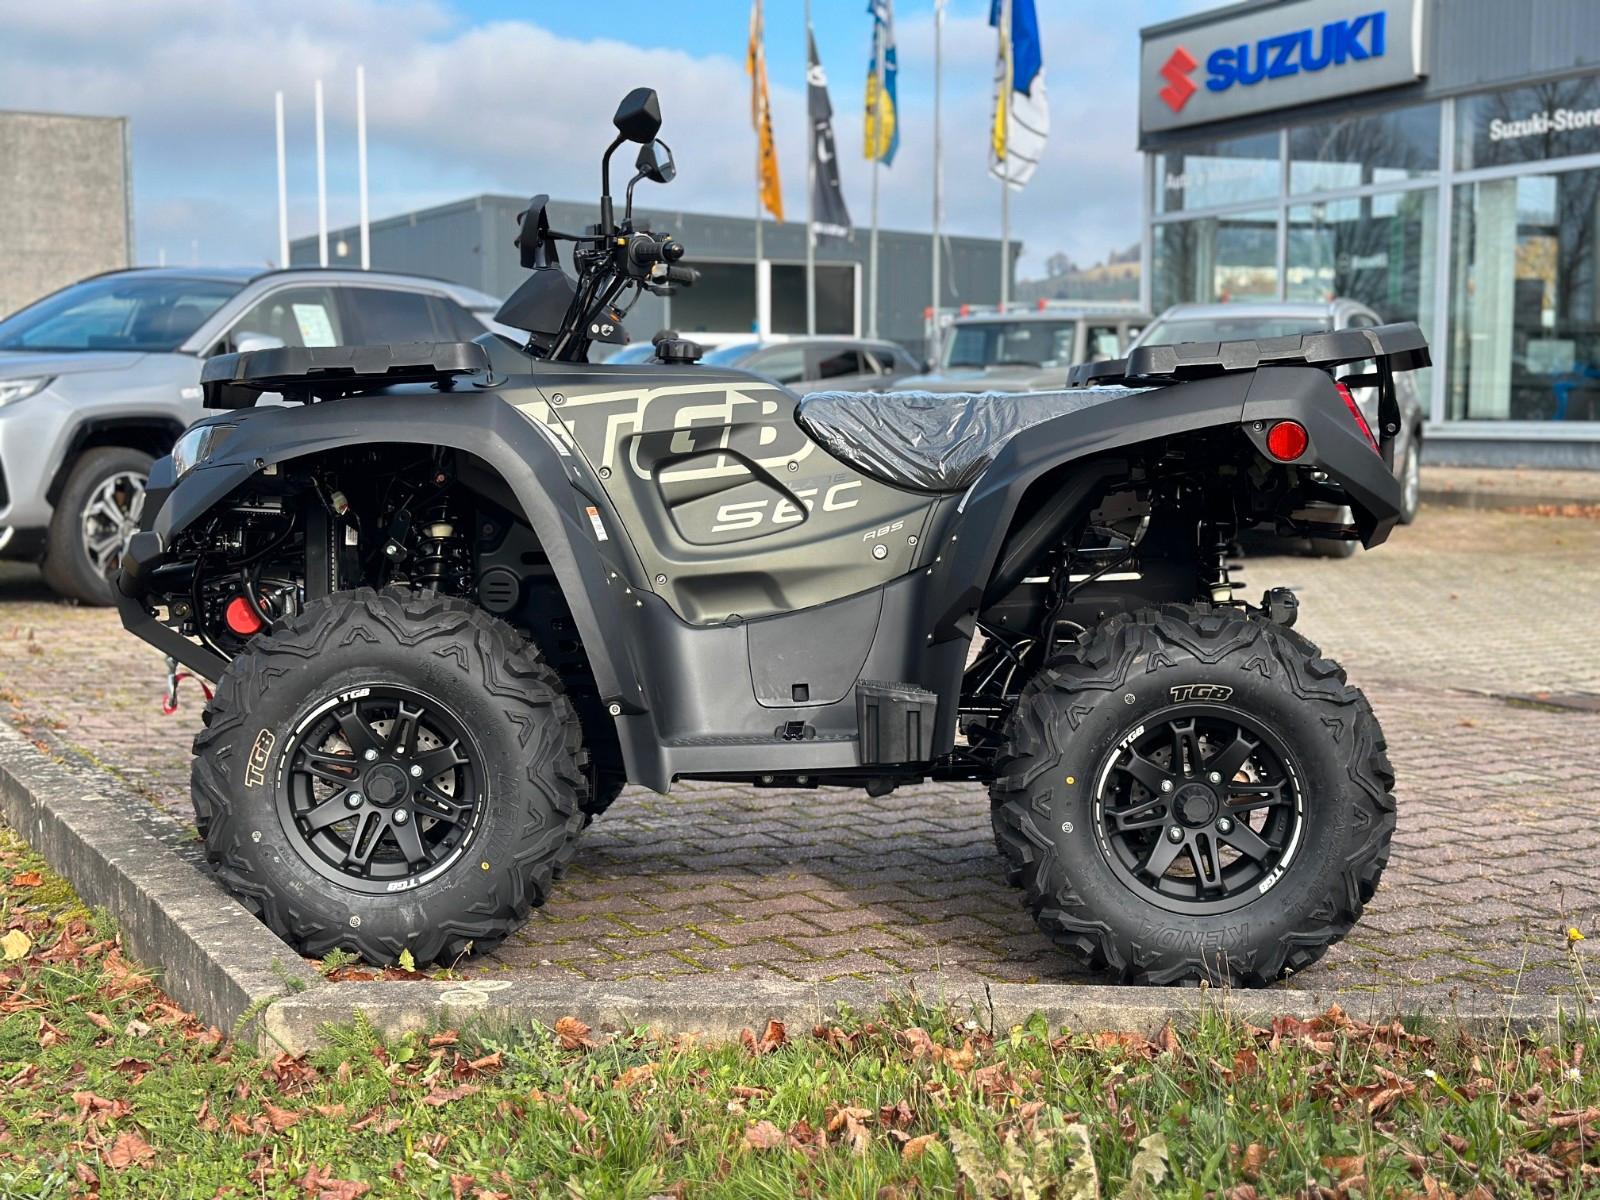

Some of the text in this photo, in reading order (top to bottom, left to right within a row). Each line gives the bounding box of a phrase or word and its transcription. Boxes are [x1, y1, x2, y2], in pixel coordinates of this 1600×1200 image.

[1206, 11, 1386, 92] SUZUKI
[514, 382, 816, 483] TGB
[863, 520, 904, 542] ABS
[339, 687, 371, 703] TGB
[1169, 683, 1234, 703] TGB
[1118, 725, 1146, 750] TGB
[244, 728, 276, 789] TGB
[386, 881, 419, 893] TGB
[1258, 868, 1285, 896] TGB
[1138, 917, 1250, 953] KENDA
